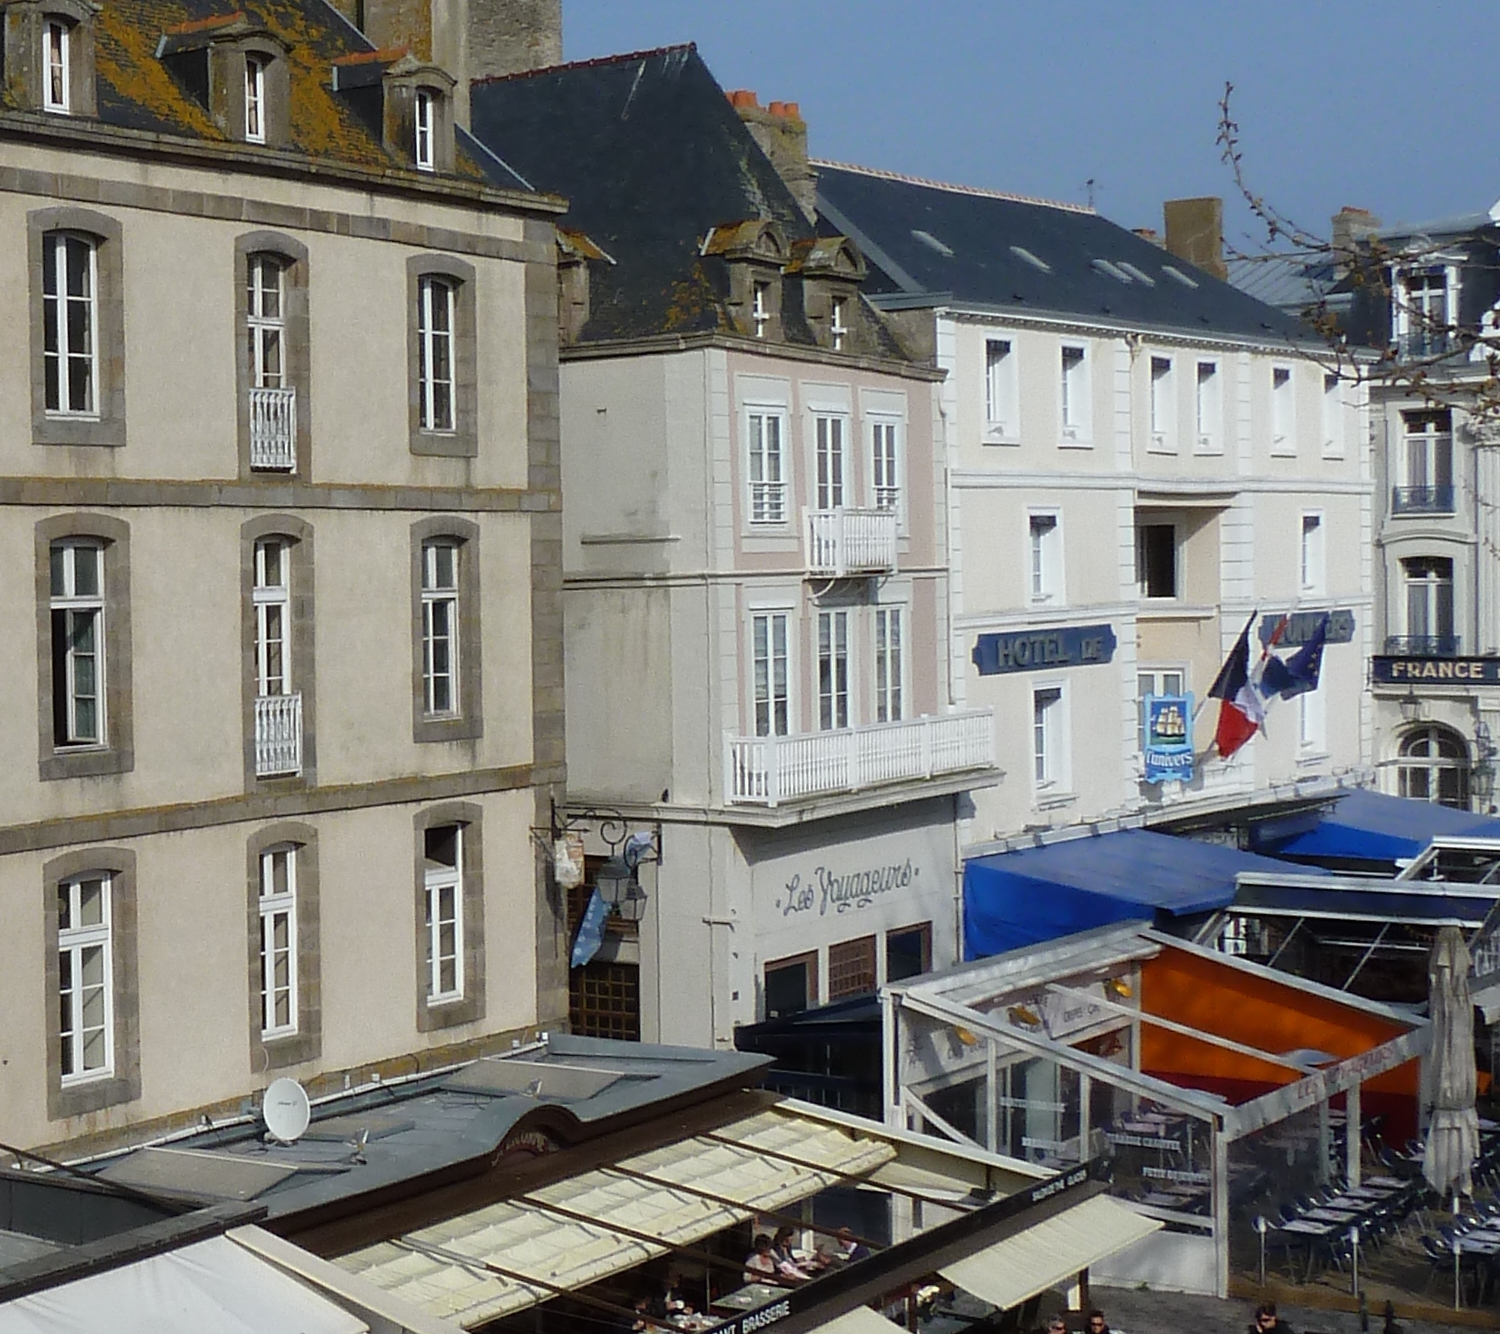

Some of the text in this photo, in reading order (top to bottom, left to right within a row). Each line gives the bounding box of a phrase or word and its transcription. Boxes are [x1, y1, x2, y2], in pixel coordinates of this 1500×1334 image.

[1391, 661, 1485, 679] FRANCE
[783, 858, 912, 916] Les Voyageurs
[742, 1300, 790, 1334] BRASSERIE
